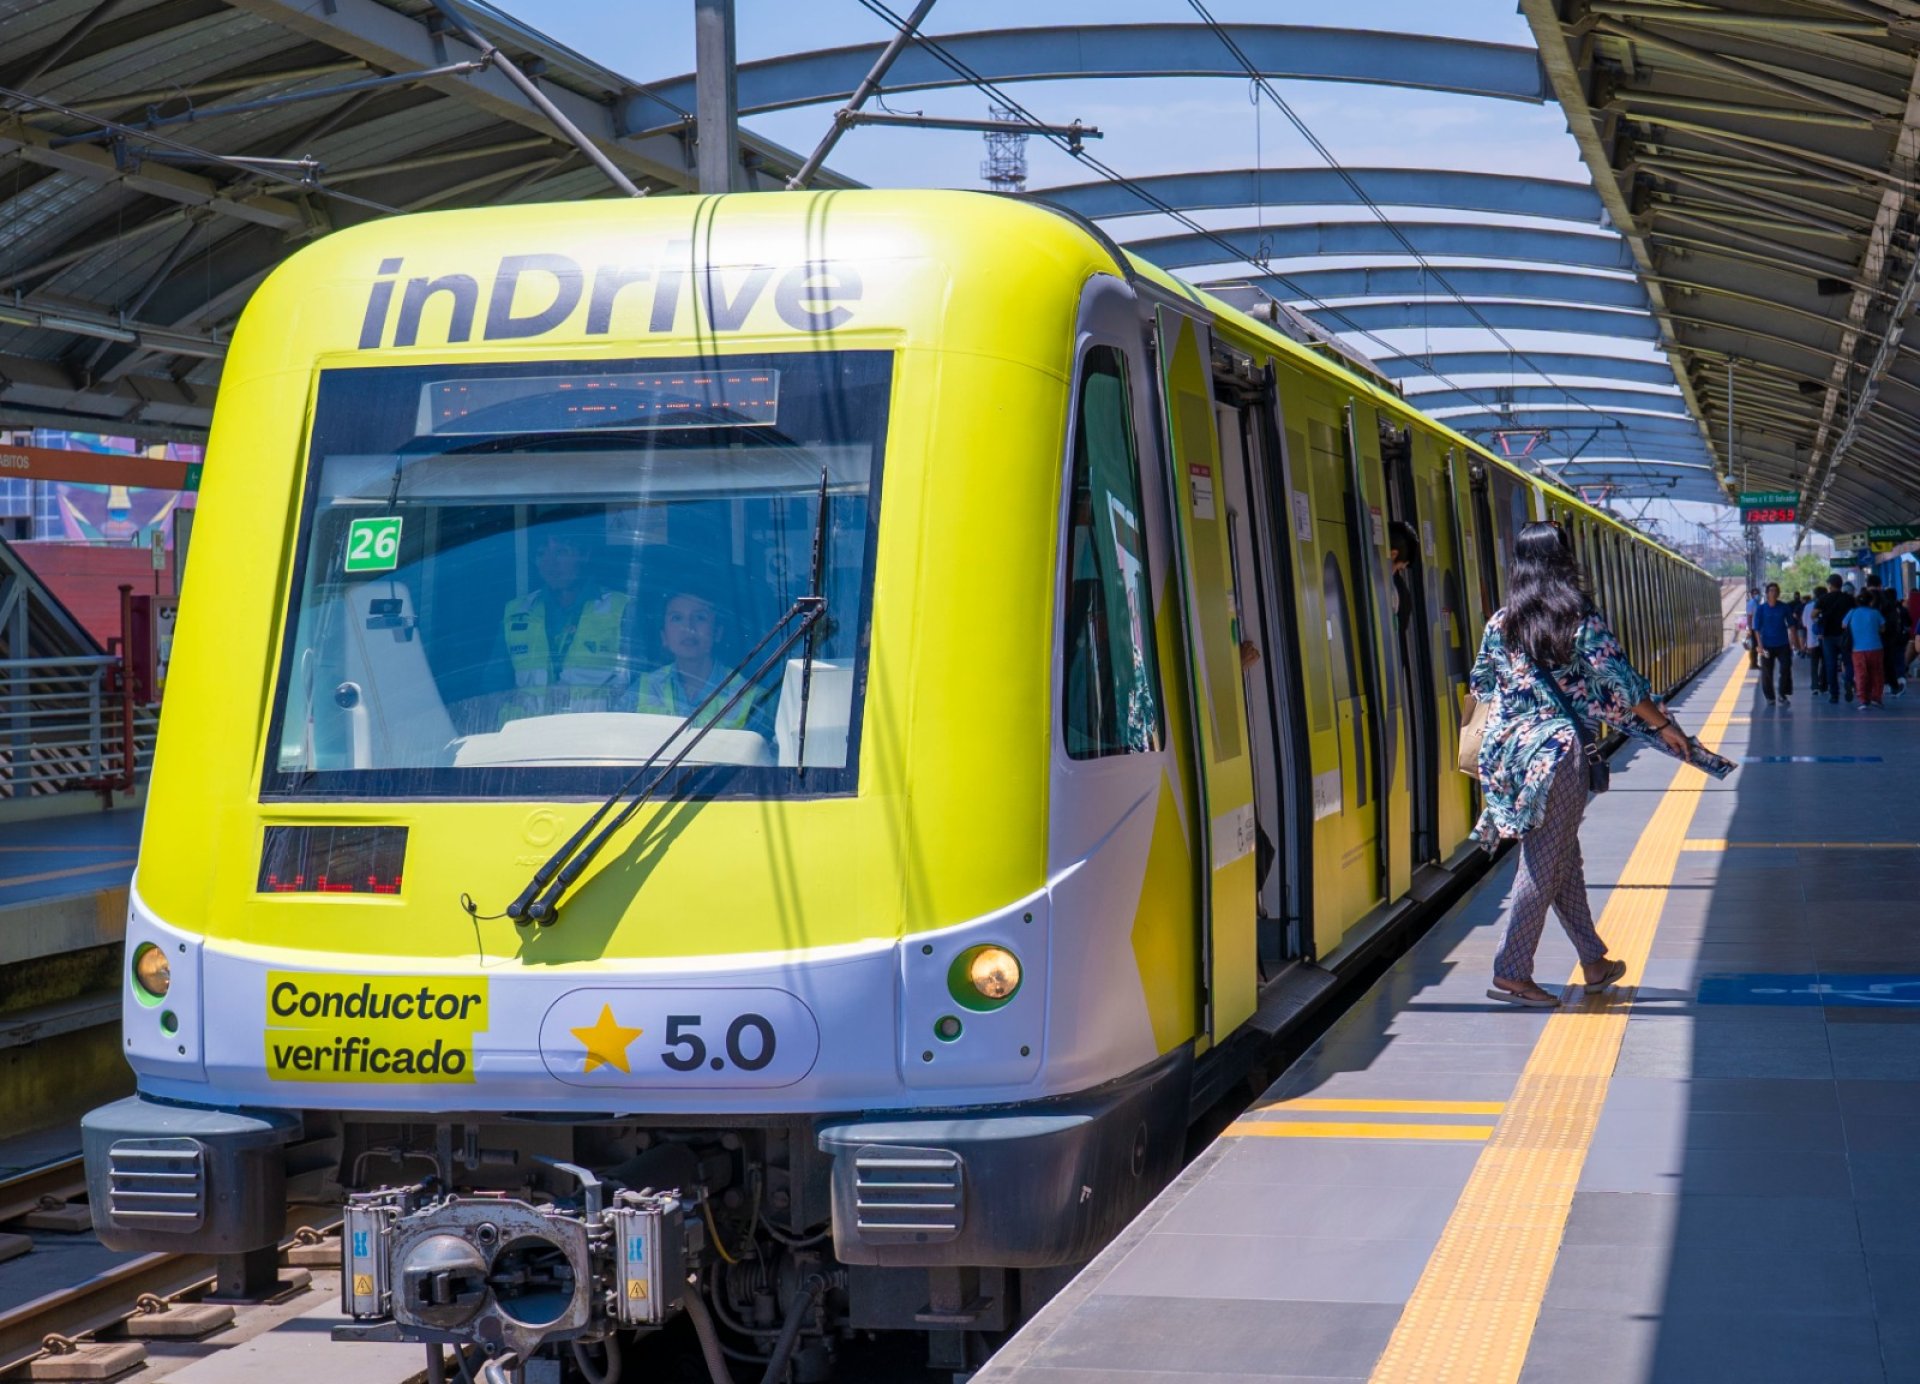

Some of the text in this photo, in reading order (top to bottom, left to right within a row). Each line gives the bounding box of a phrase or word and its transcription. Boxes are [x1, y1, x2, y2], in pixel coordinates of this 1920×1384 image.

[358, 240, 863, 350] inDrive
[350, 527, 397, 559] 26
[1869, 529, 1902, 538] SALIDA
[271, 981, 482, 1020] Conductor
[272, 1035, 467, 1076] verificado
[661, 1012, 777, 1072] 5.0
